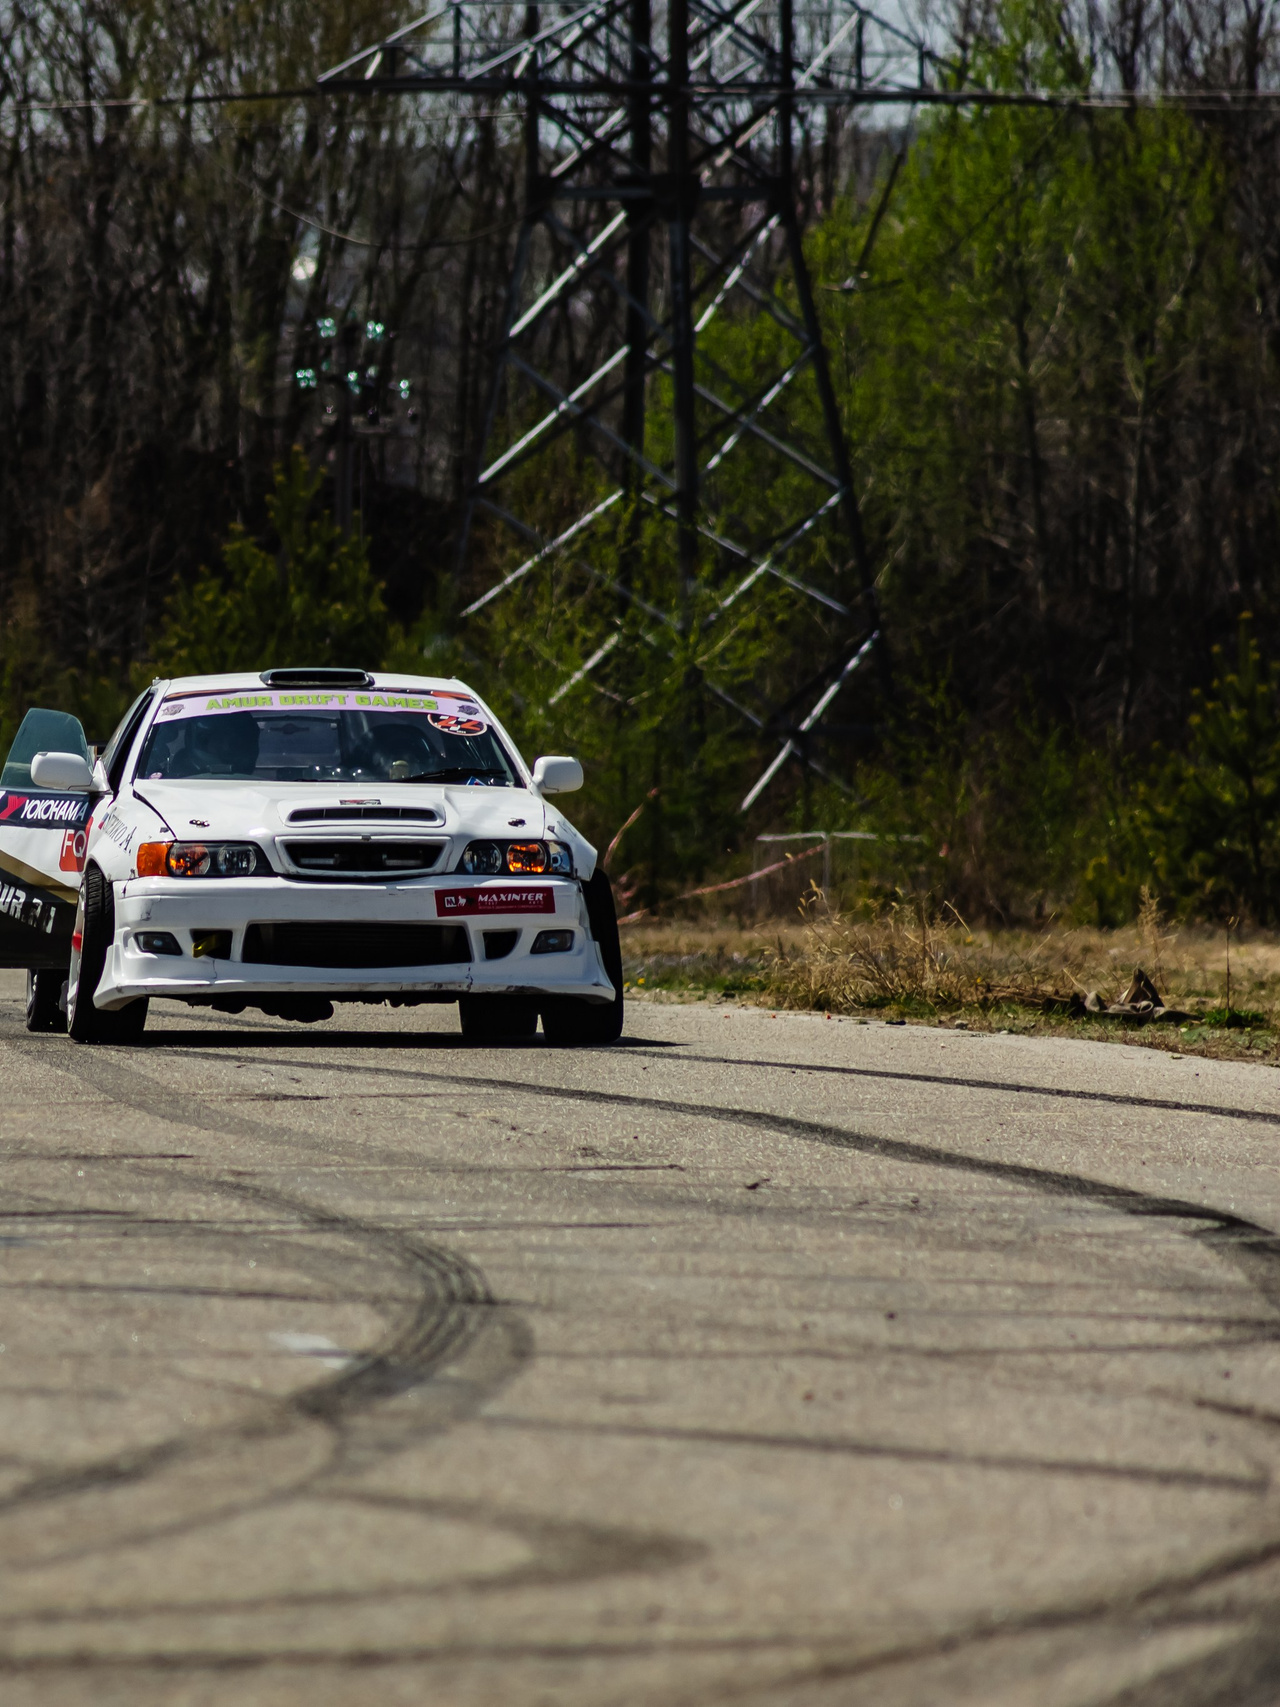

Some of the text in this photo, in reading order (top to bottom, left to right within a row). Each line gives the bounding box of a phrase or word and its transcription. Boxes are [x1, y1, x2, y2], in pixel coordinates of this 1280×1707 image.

[205, 694, 439, 711] AMUR DRIFT GAMES
[20, 799, 89, 821] YOKOHAMA
[63, 829, 87, 858] FQ
[478, 893, 544, 902] MAXINTER
